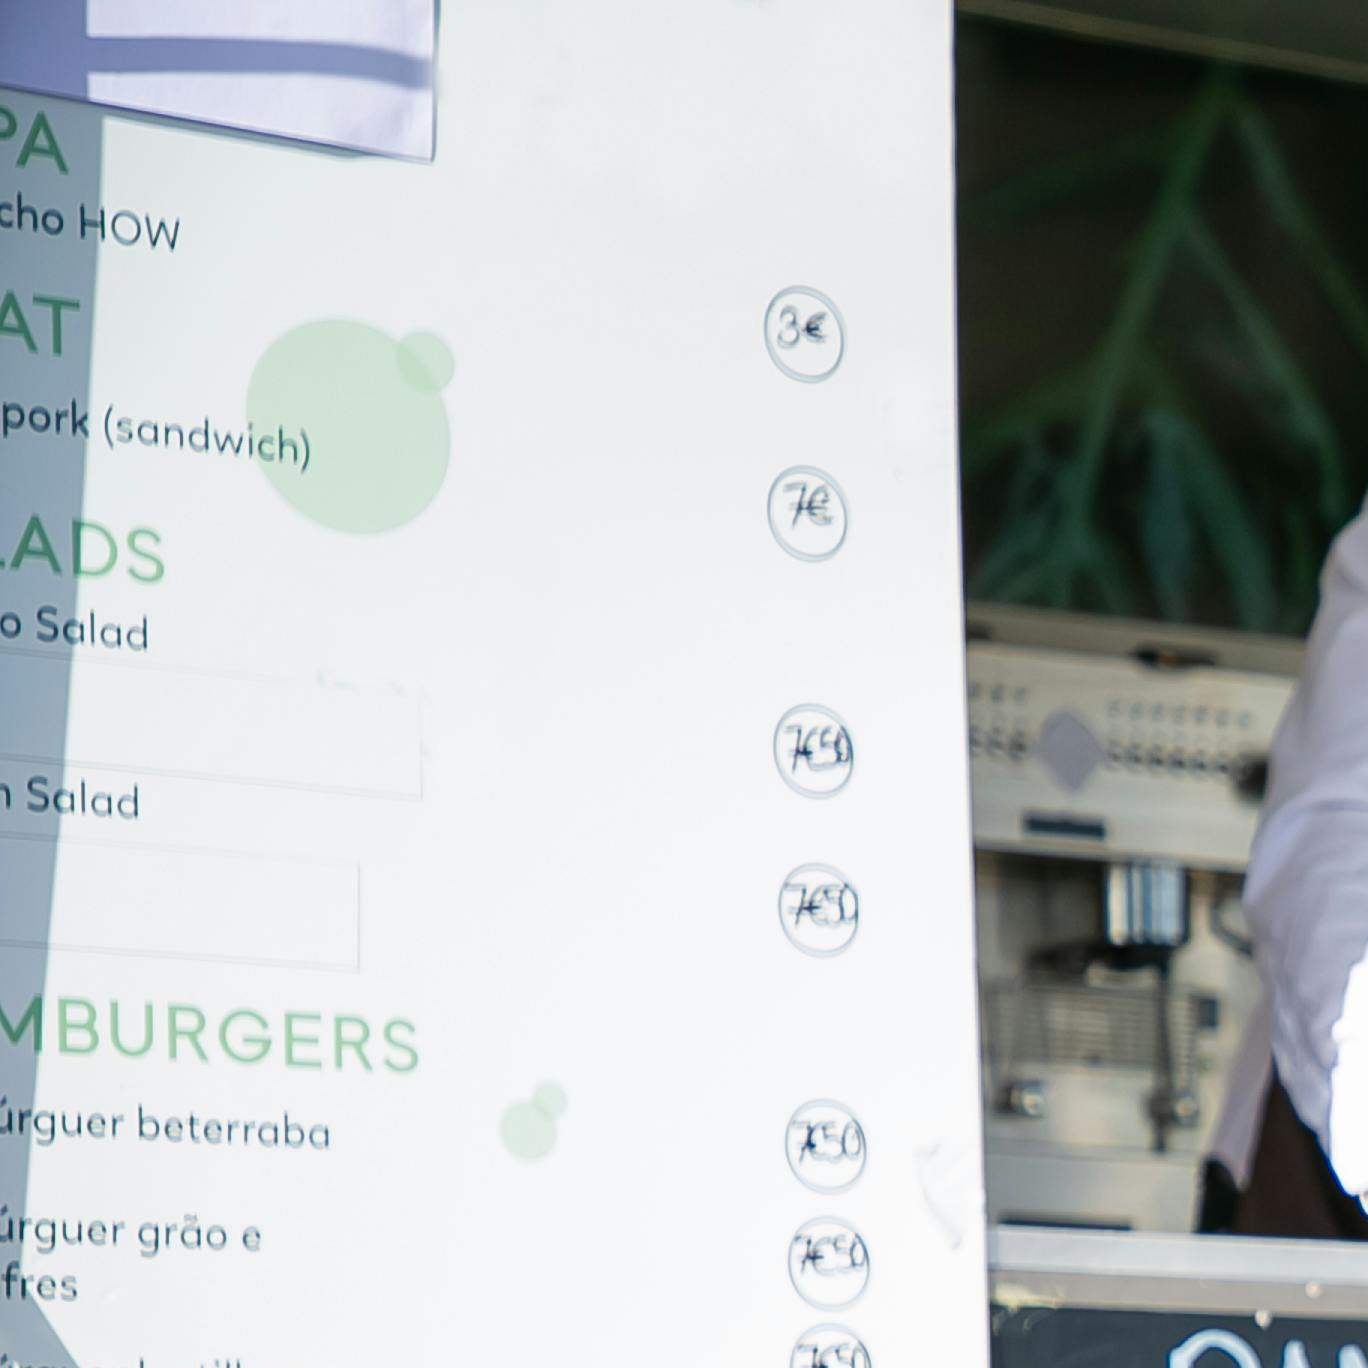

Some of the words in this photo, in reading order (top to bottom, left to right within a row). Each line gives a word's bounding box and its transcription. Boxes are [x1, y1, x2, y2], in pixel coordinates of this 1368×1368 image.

[78, 203, 181, 252] HOW
[0, 289, 81, 357] AT
[777, 304, 828, 350] 3€
[2, 398, 89, 438] pork
[104, 403, 311, 475] (sandwich)
[0, 513, 165, 585] ADS
[36, 605, 148, 651] Salad
[27, 775, 139, 819] Salad
[0, 994, 419, 1072] MBURGERS
[138, 1103, 330, 1149] beterraba
[138, 1213, 228, 1258] grão
[242, 1226, 262, 1252] e
[1, 1261, 78, 1301] fres
